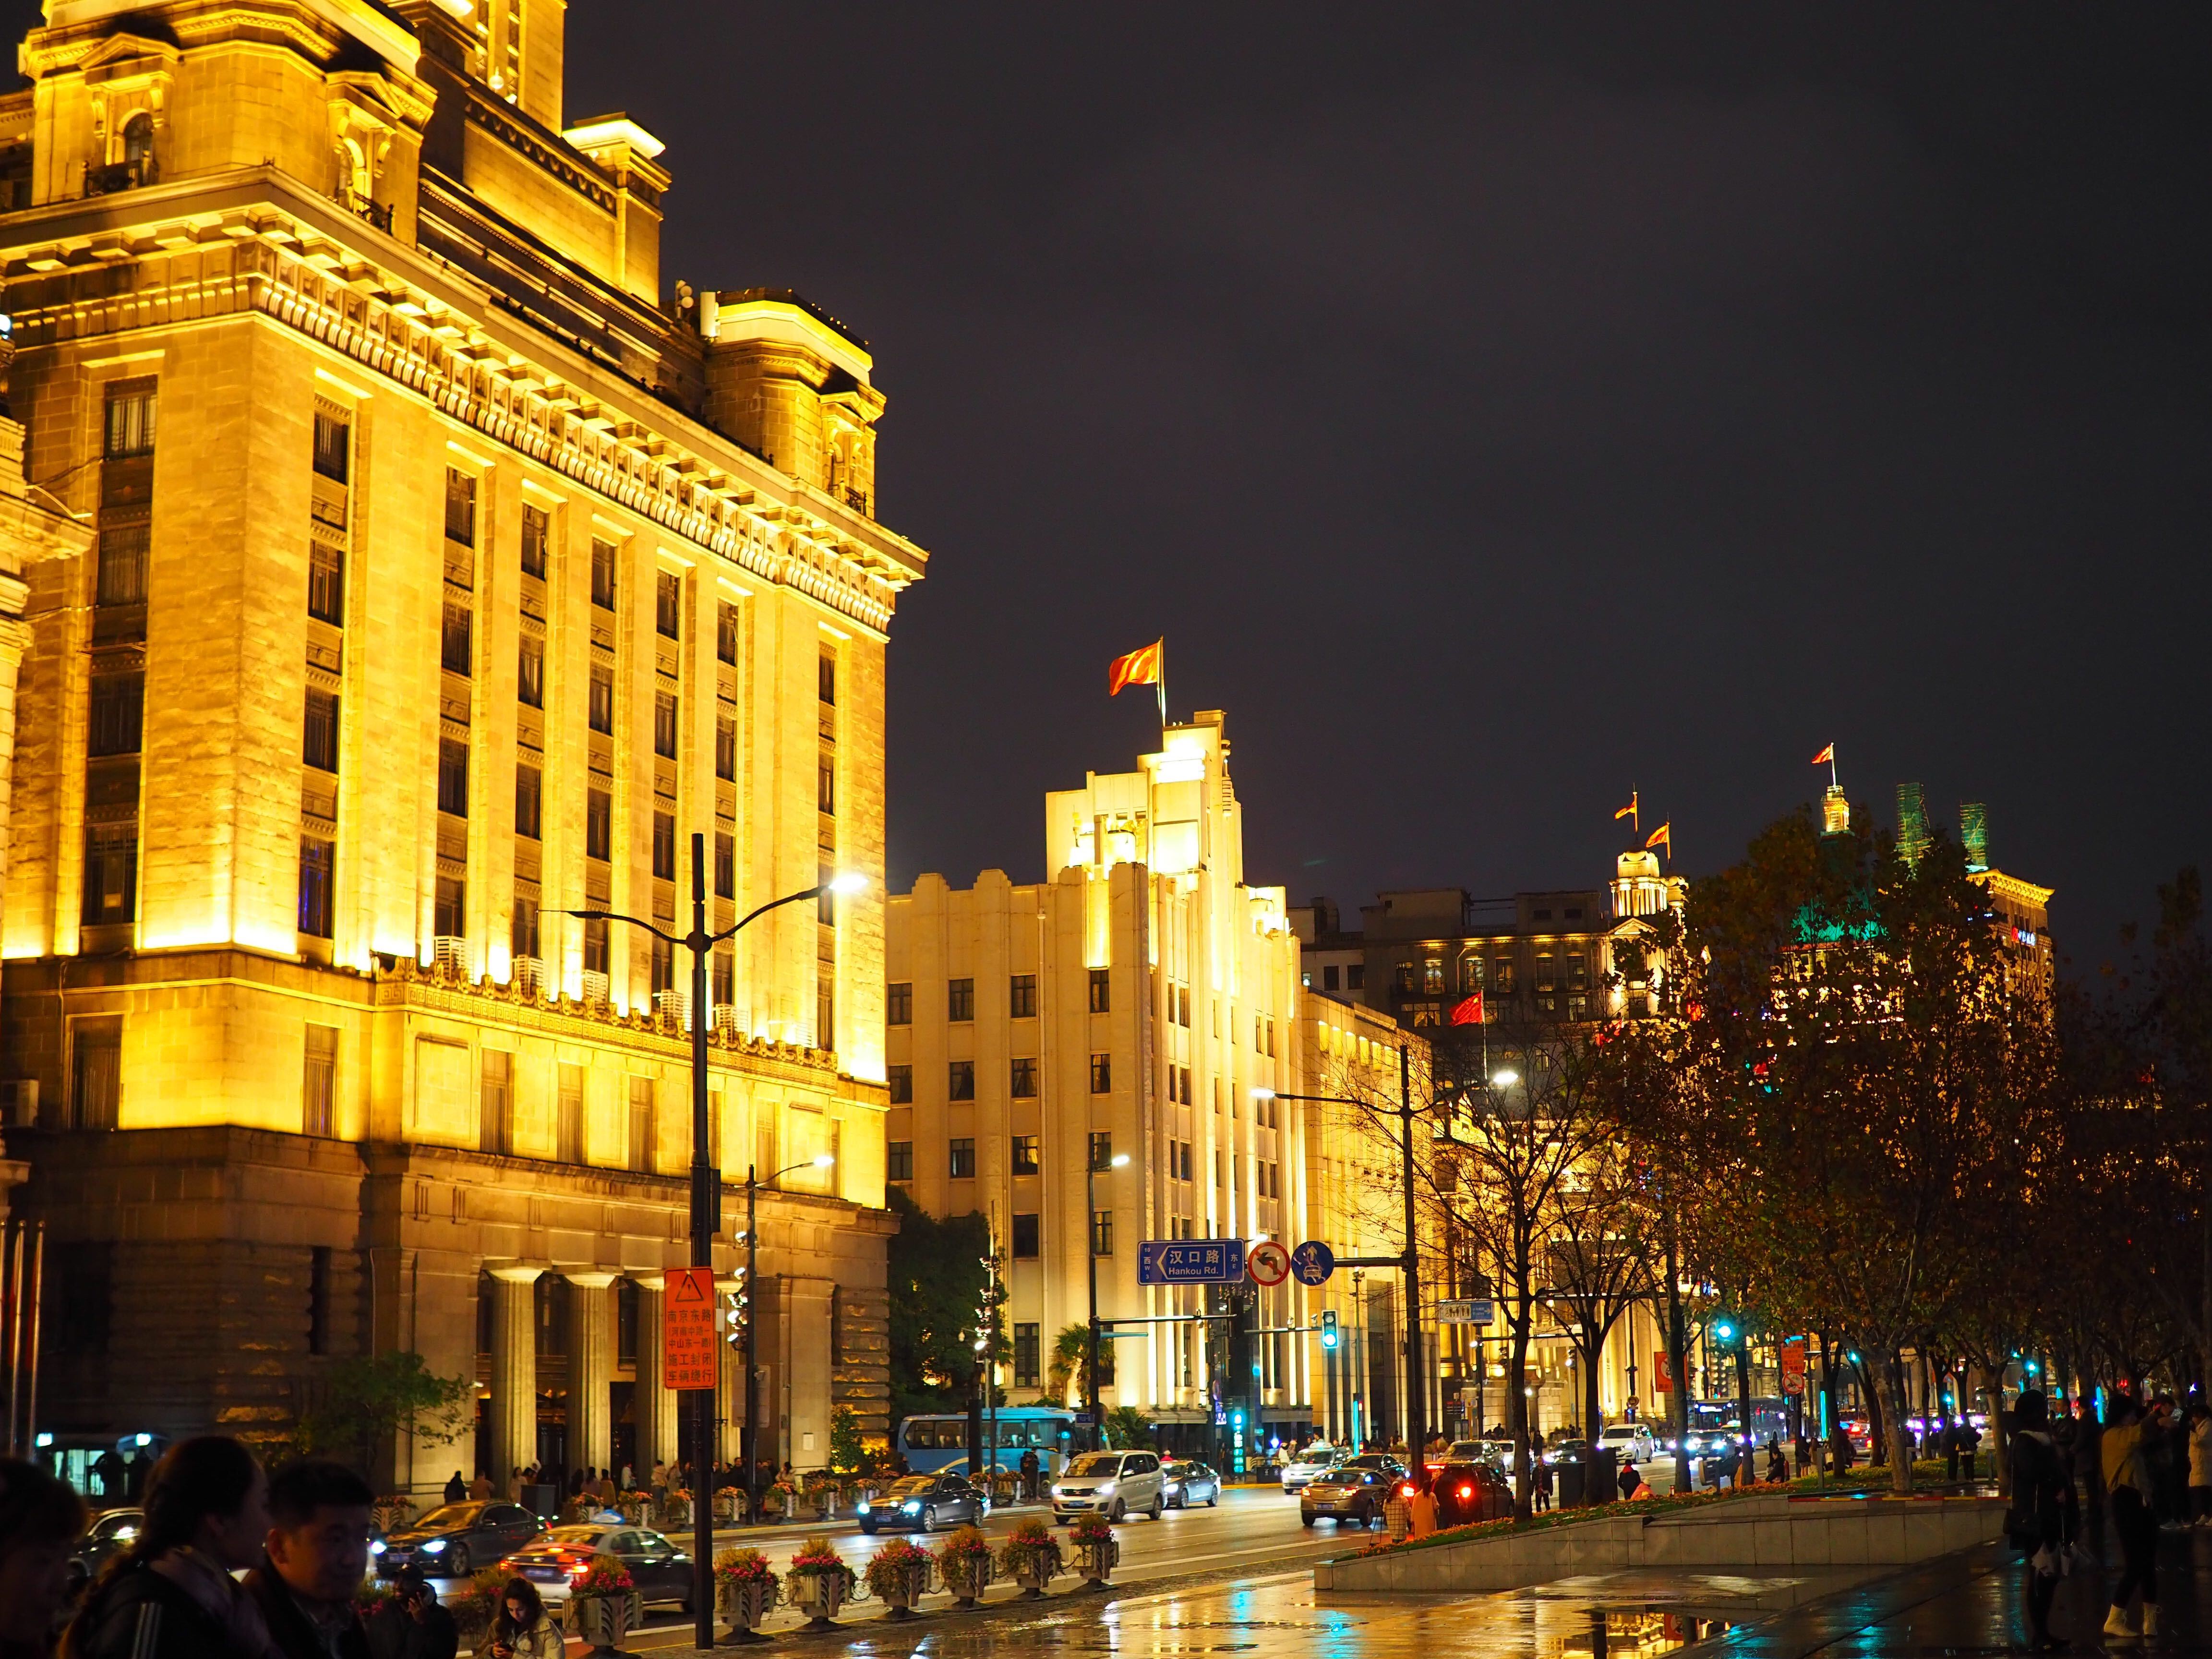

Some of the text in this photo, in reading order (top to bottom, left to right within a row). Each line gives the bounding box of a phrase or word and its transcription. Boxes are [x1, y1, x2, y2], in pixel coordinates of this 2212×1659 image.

[1143, 1256, 1151, 1264] 西
[1169, 1249, 1219, 1264] 汉口路
[1230, 1253, 1238, 1262] 东
[1168, 1267, 1202, 1275] Hankou
[668, 1308, 711, 1323] 南京东路
[668, 1352, 712, 1367] 施工封闭
[667, 1369, 712, 1383] 车辆绕行
